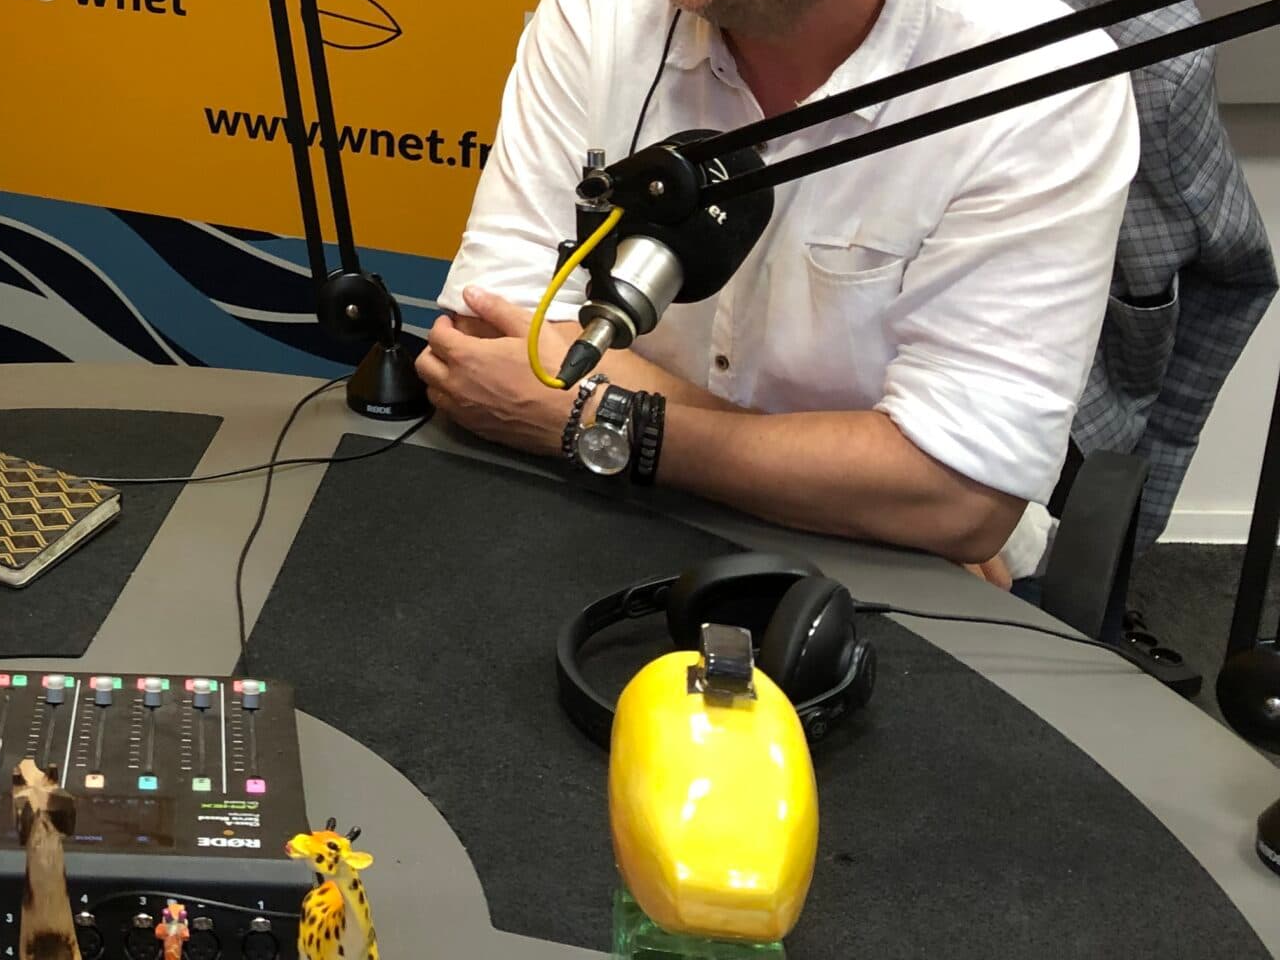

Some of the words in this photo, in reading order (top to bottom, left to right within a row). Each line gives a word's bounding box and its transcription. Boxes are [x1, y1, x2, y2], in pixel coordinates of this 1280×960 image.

[80, 894, 89, 904] 4
[139, 896, 148, 906] 3
[257, 900, 265, 910] 1
[5, 913, 14, 923] 3
[5, 946, 14, 956] 4
